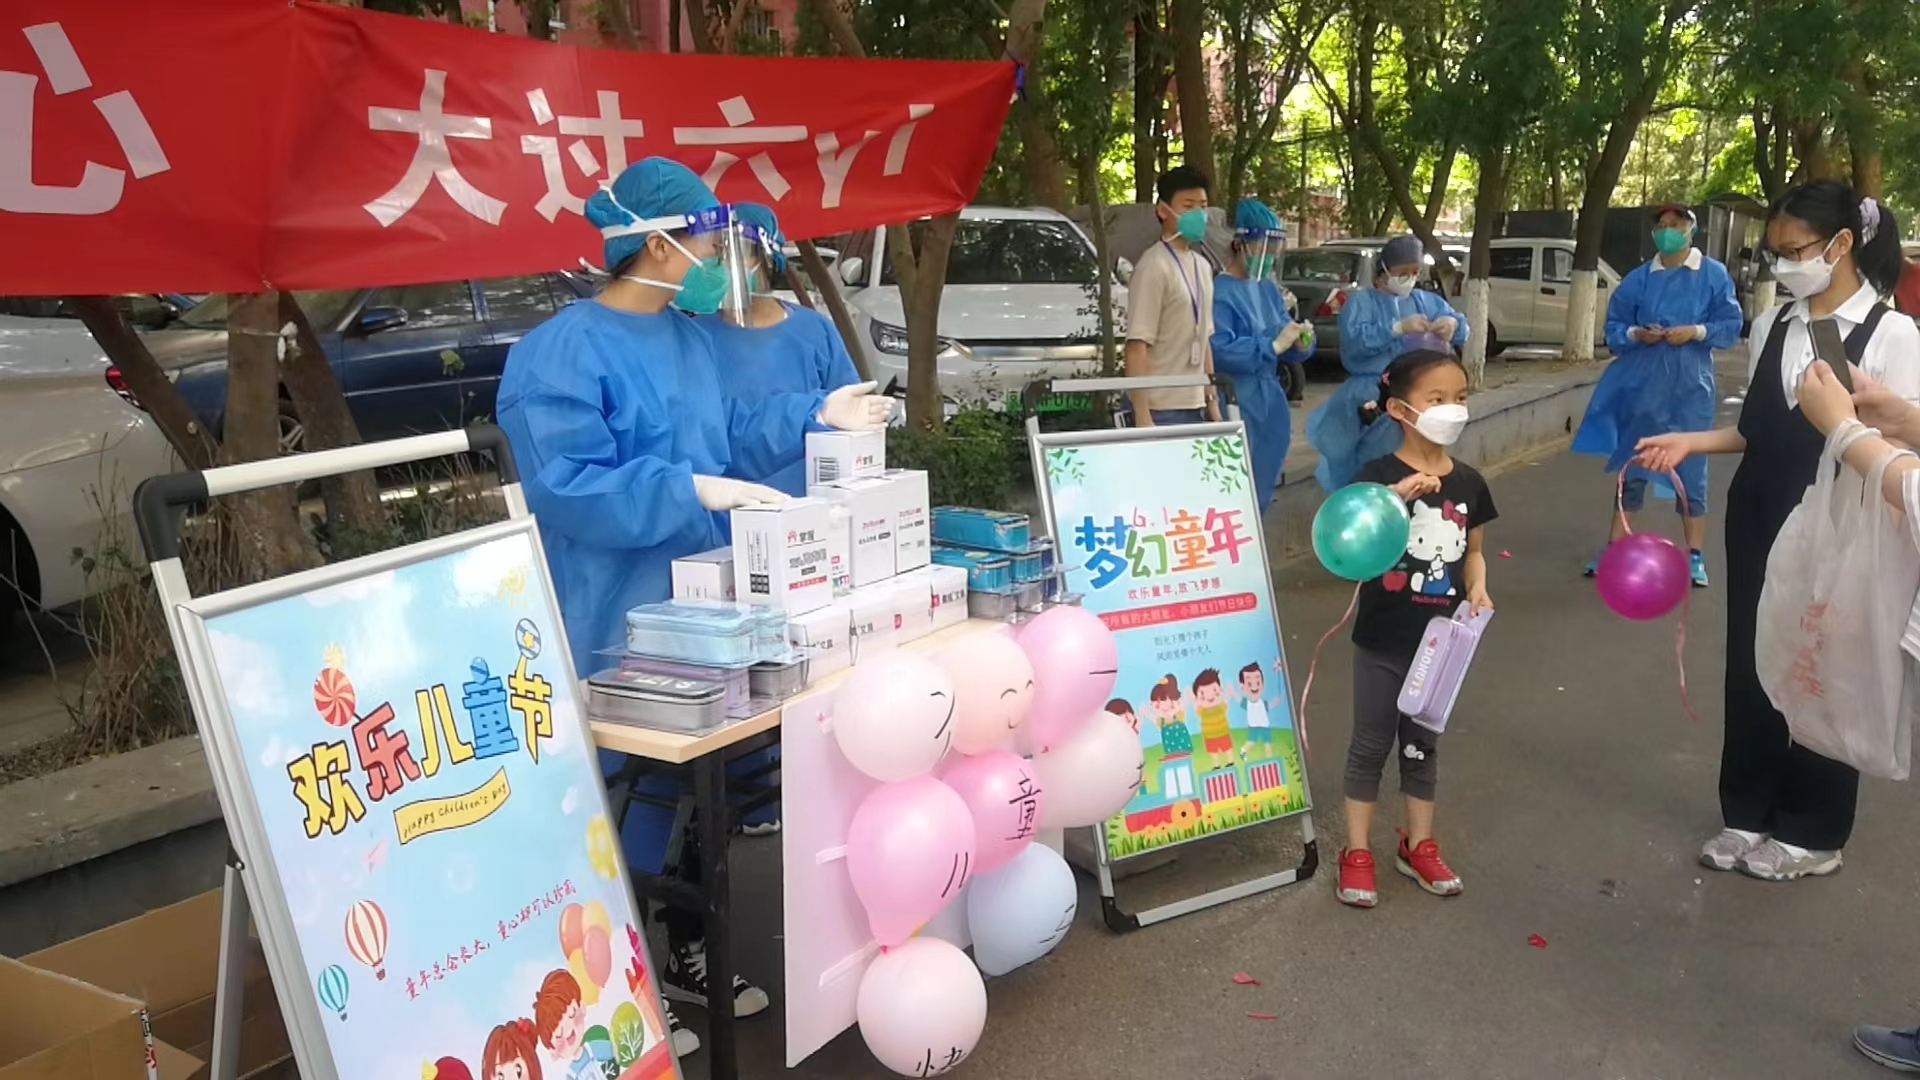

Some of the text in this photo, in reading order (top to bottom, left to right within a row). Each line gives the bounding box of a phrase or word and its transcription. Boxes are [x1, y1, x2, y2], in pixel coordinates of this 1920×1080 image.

[0, 21, 171, 215] 心
[1074, 507, 1253, 590] 梦幻童年
[286, 656, 554, 840] 欢乐儿童节
[1005, 768, 1042, 841] 童
